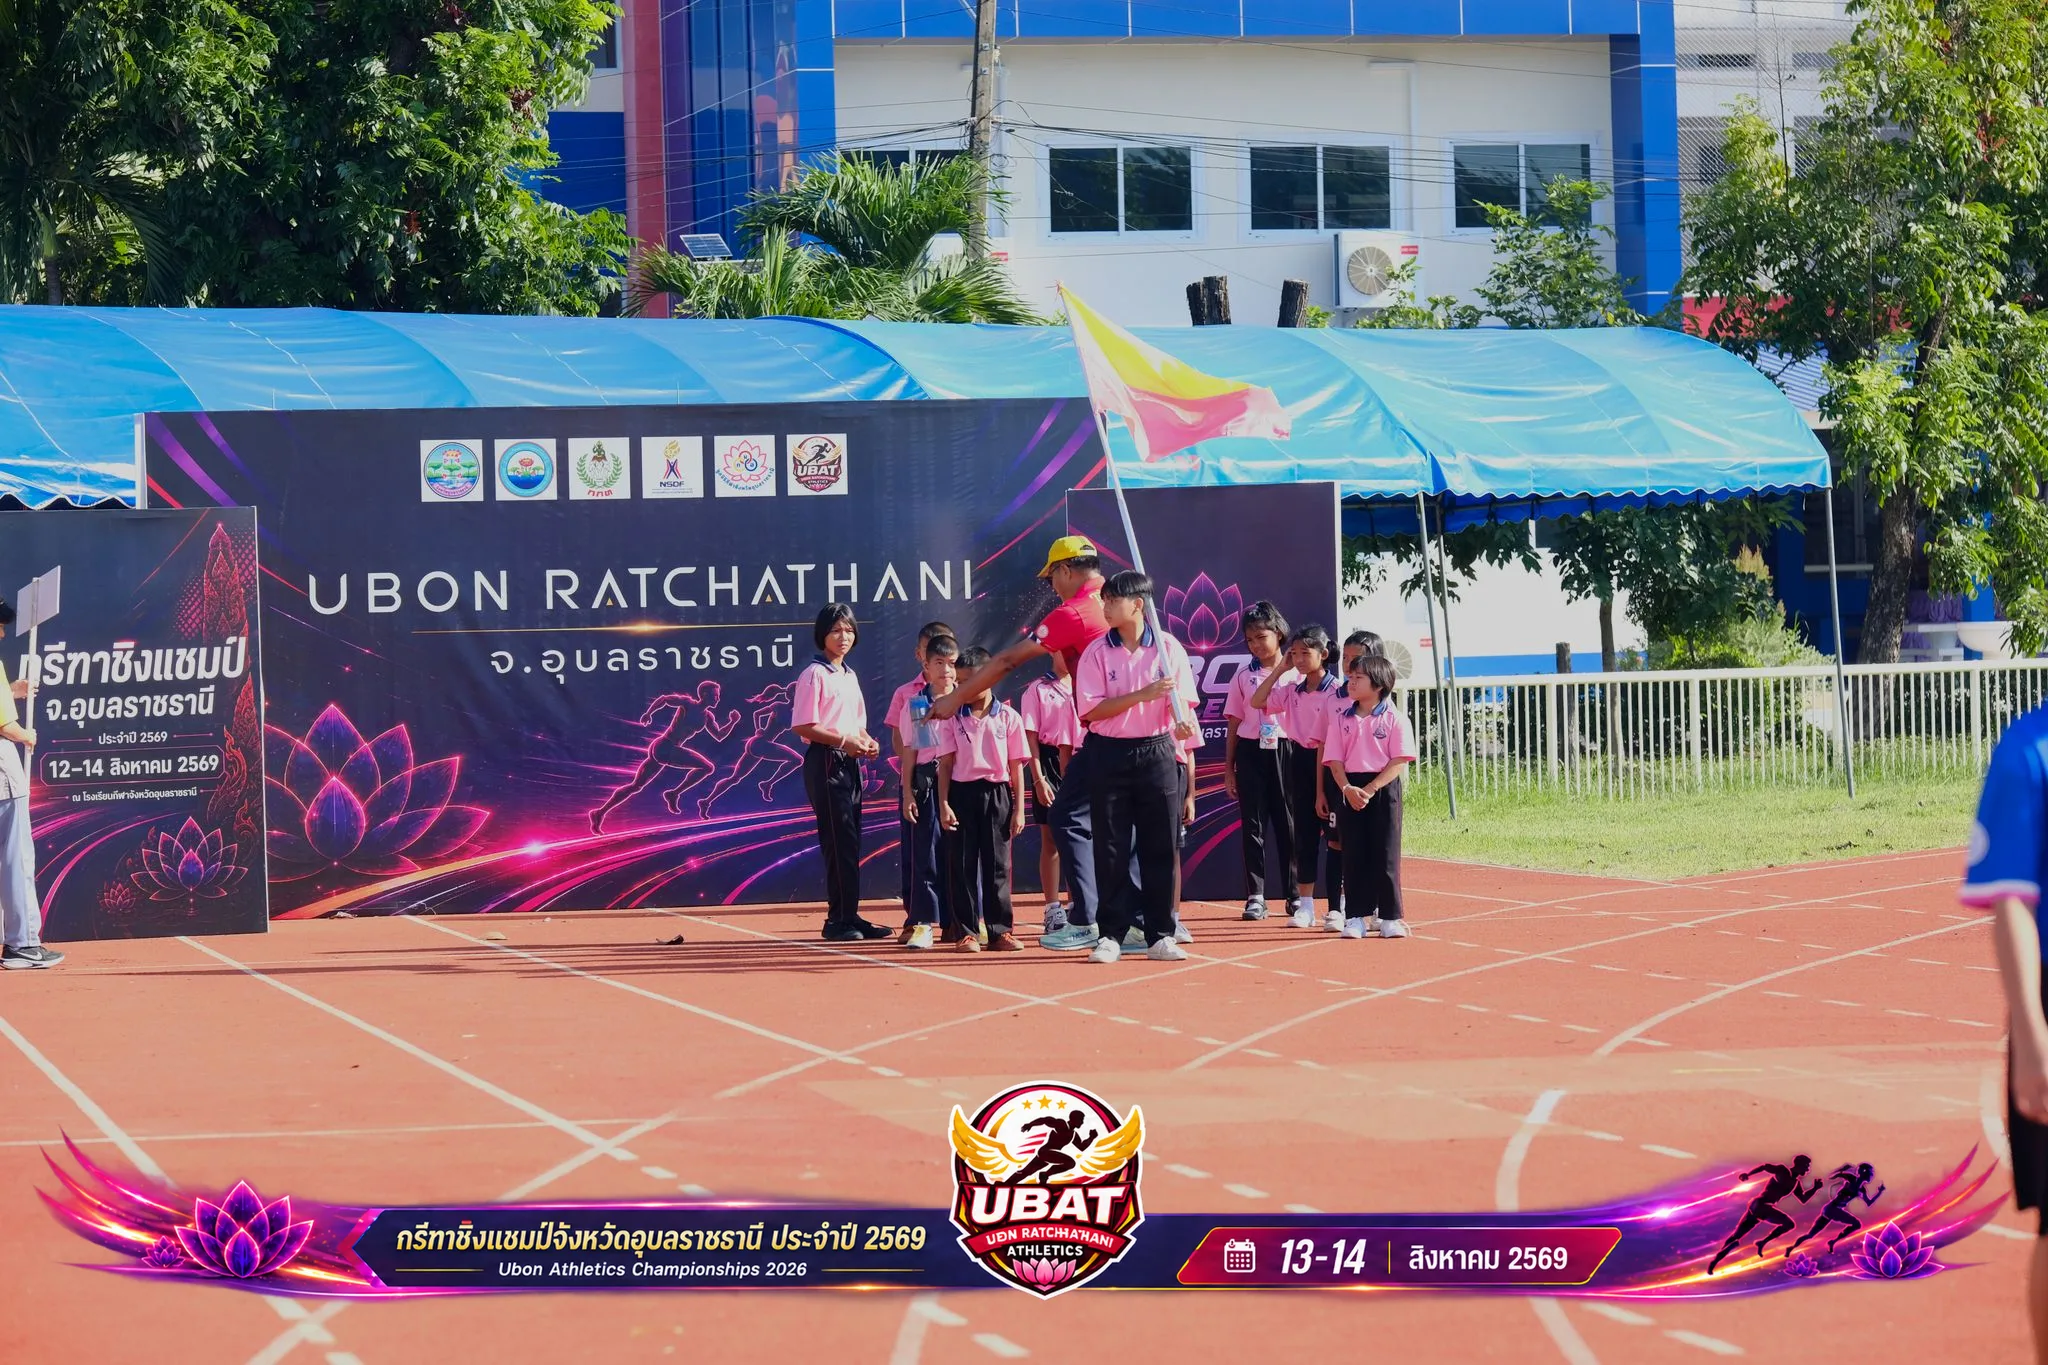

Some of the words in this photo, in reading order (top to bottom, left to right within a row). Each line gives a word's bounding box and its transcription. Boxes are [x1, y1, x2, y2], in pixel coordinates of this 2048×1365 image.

[796, 465, 838, 477] UBAT
[308, 570, 508, 616] UBON
[545, 559, 972, 610] RATCHATHANI
[490, 634, 794, 685] จ.อุบลราชธานี
[46, 684, 215, 729] จ.อุบลราชธานี
[98, 731, 137, 745] ประจำปี
[140, 731, 168, 743] 2569
[110, 757, 172, 776] สิงหาคม
[177, 754, 219, 773] 2569
